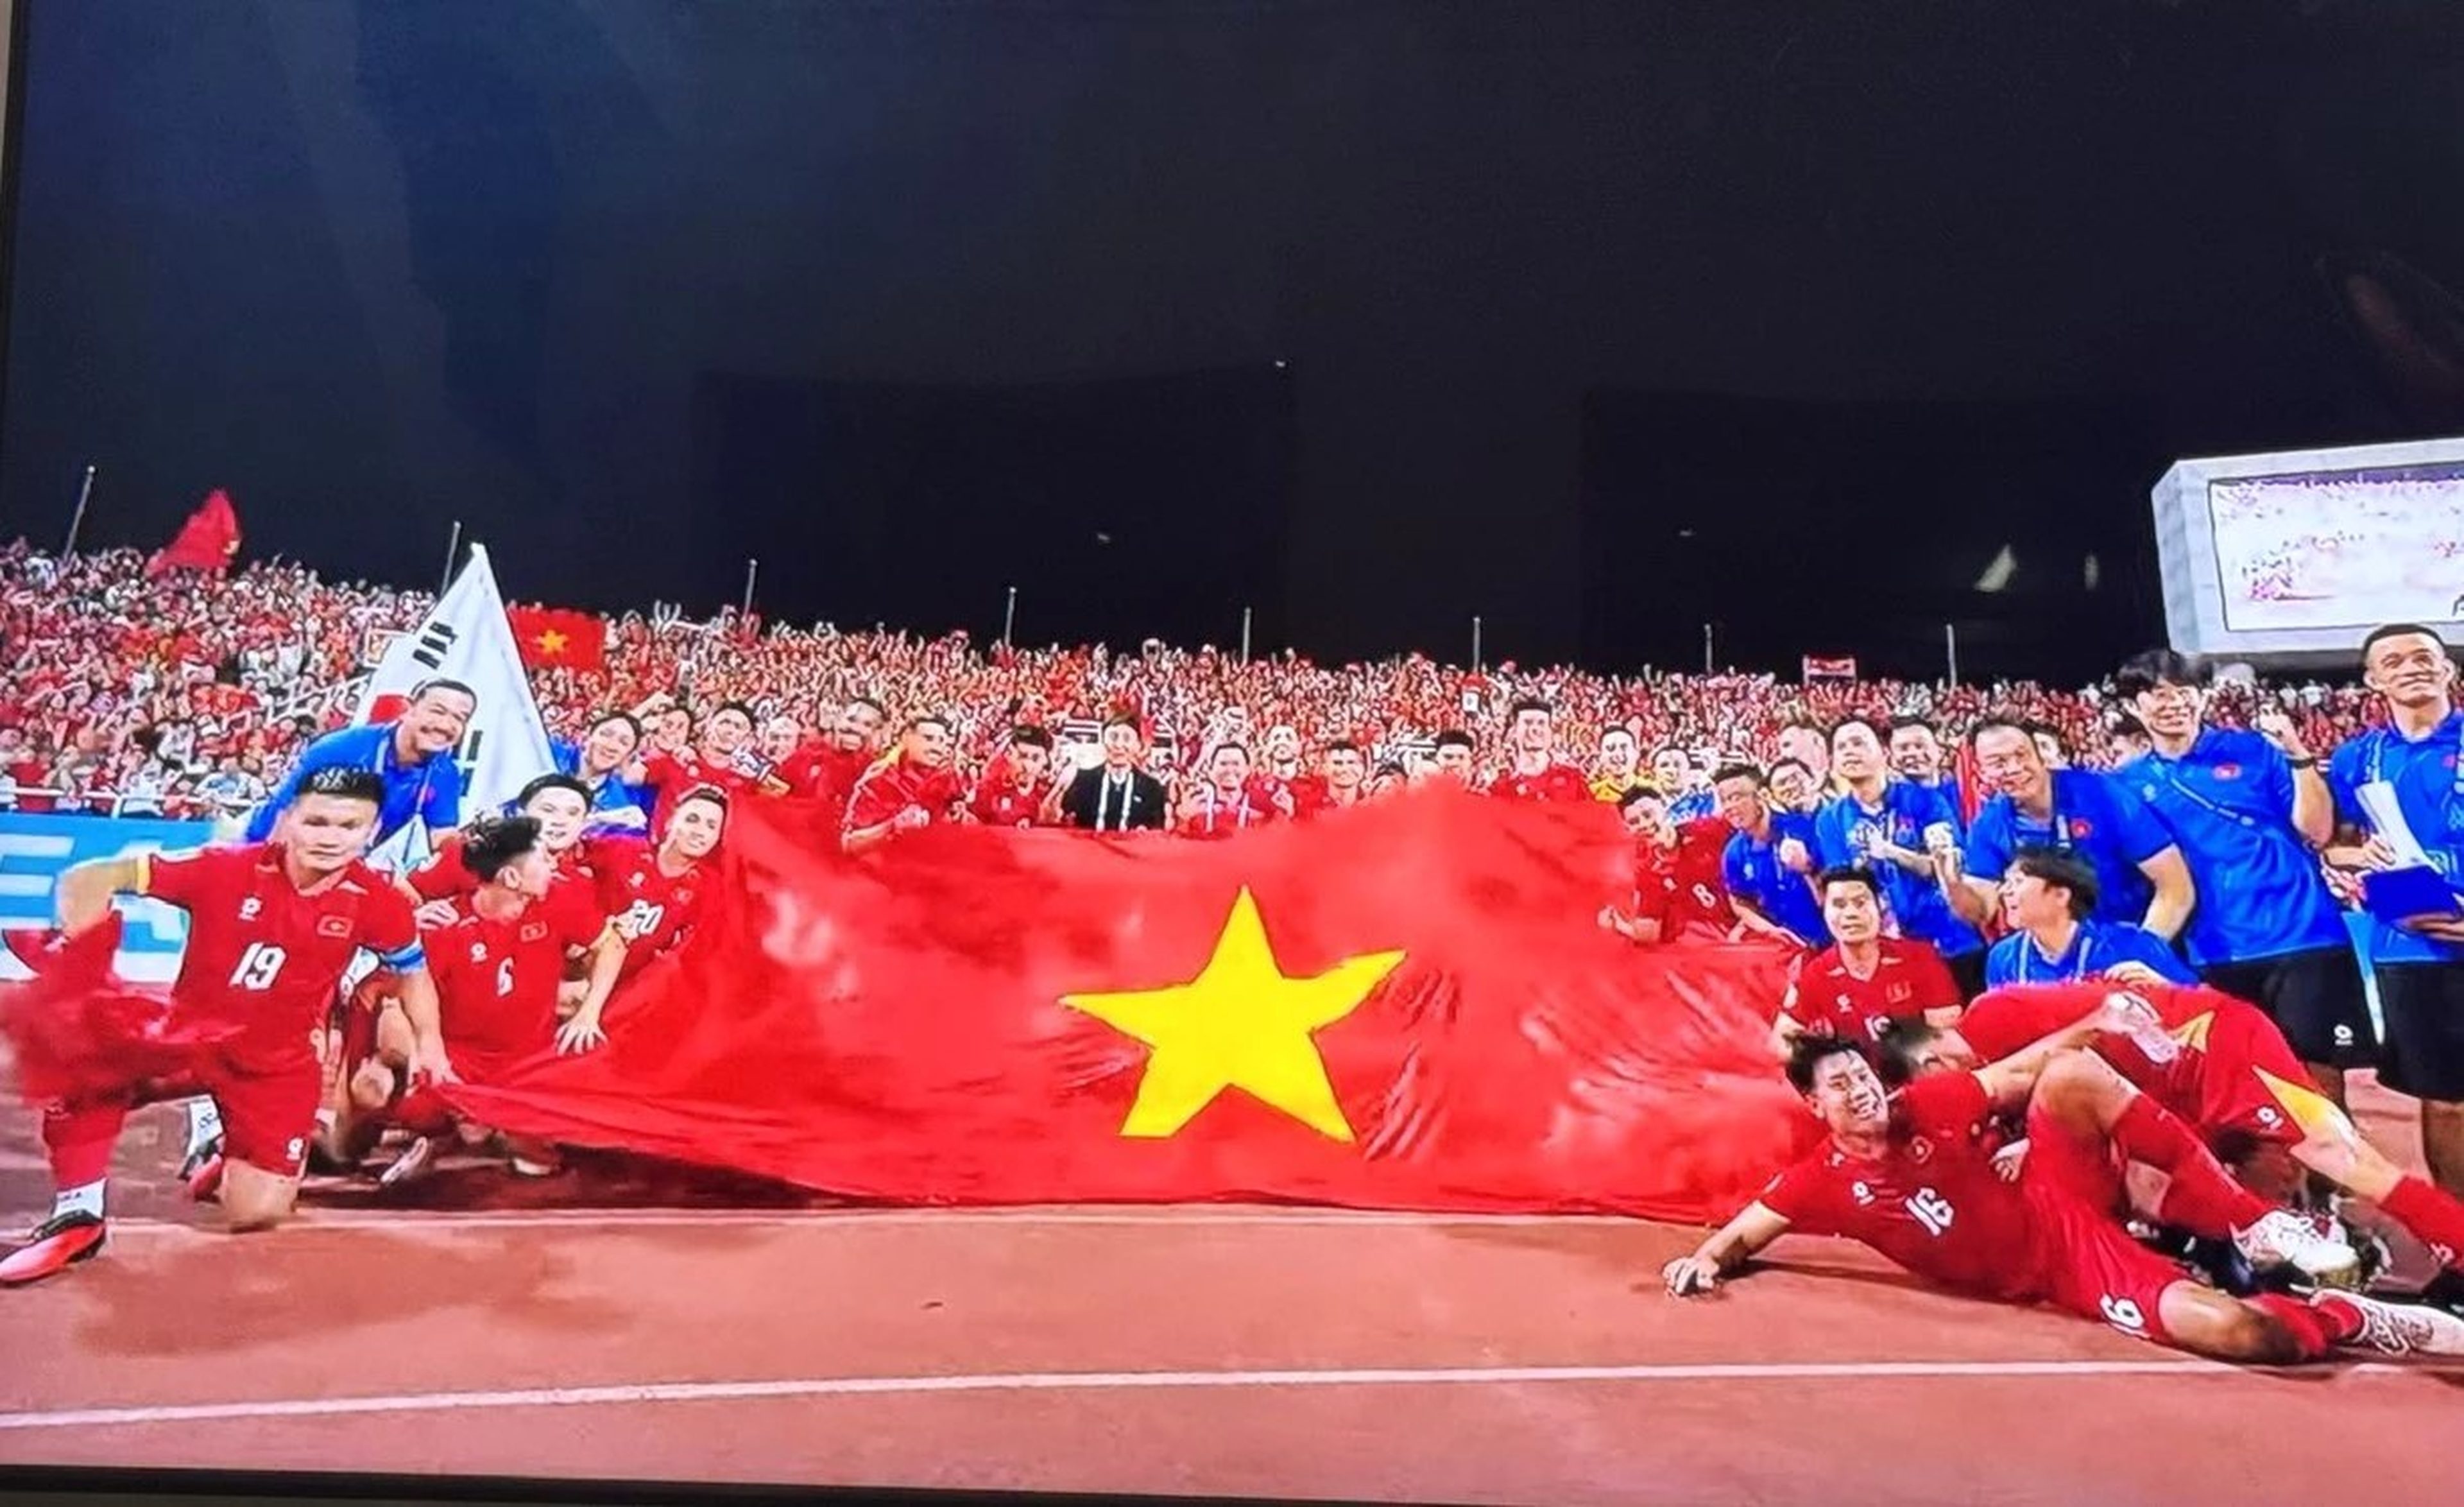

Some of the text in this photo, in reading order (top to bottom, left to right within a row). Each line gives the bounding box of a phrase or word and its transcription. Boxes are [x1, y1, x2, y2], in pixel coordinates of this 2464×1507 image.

[1693, 884, 1716, 908] 8
[228, 943, 287, 990] 19
[497, 956, 513, 996] 6
[1905, 1187, 1954, 1236] 16
